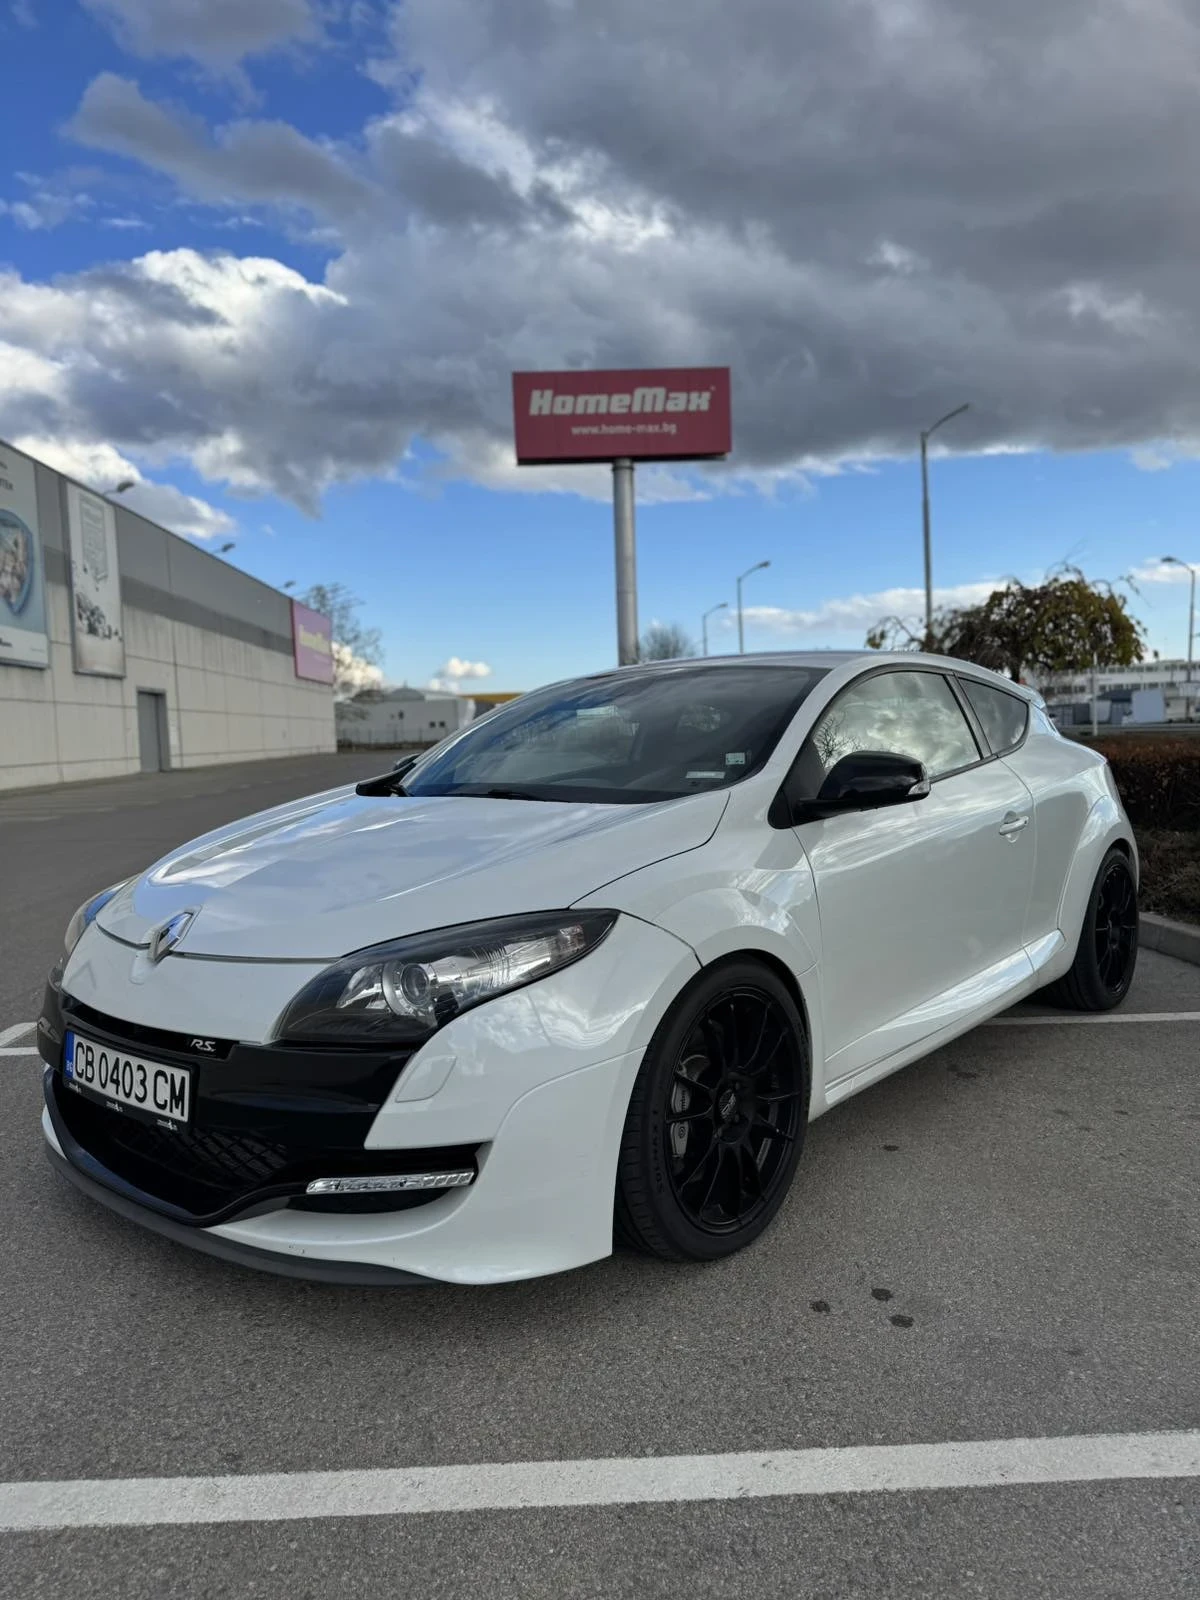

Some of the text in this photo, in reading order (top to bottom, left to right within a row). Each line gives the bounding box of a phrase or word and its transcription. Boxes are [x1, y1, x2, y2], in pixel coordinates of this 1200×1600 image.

[529, 387, 712, 416] HomeMax
[571, 422, 677, 436] www.home-max.bg
[75, 1041, 186, 1117] CB 0403 CM
